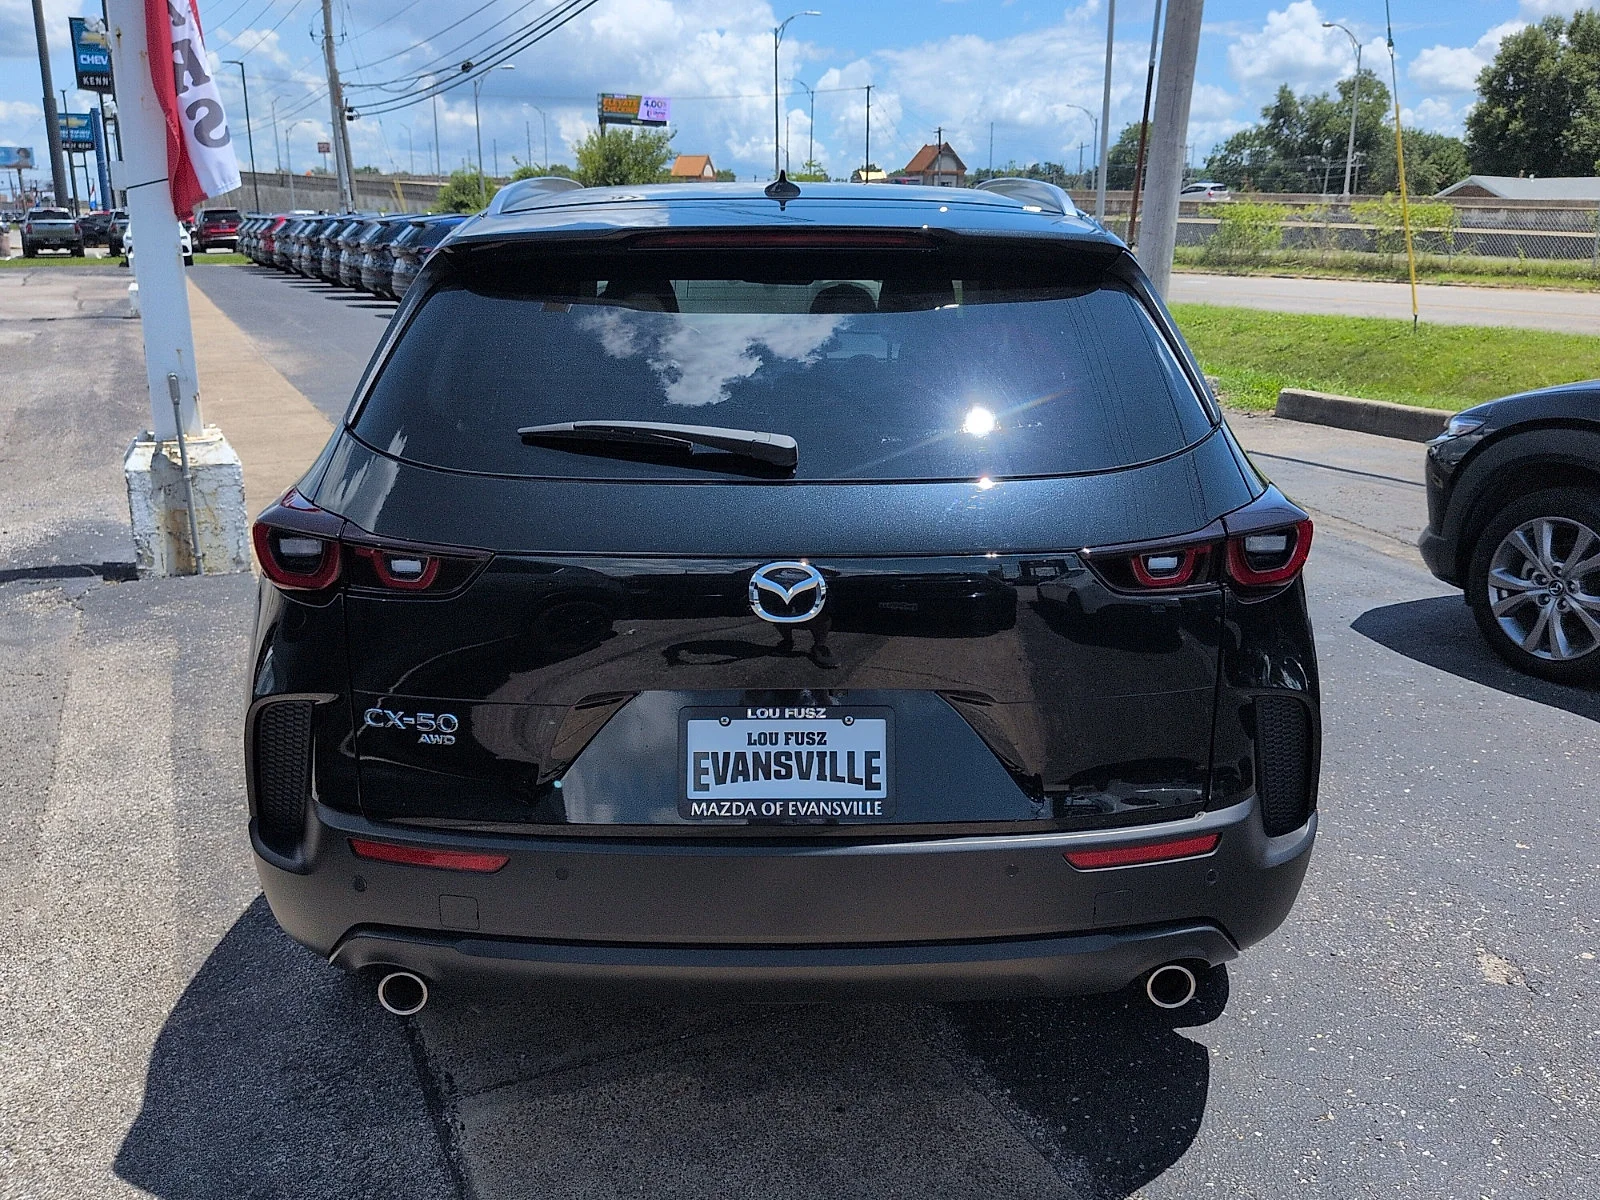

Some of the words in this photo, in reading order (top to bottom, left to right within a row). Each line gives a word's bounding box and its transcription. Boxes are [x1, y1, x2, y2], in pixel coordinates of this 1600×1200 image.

[83, 75, 111, 86] KENN
[364, 708, 458, 733] CX-50
[746, 707, 780, 719] LOU
[784, 707, 827, 719] FUSZ
[417, 733, 456, 745] AWD
[747, 731, 779, 746] LOU
[784, 731, 827, 746] FUSZ
[693, 750, 882, 792] EVANSVILLE
[690, 801, 757, 817] MAZDA
[761, 801, 784, 816] OF
[789, 801, 883, 816] EVANSVILLE
